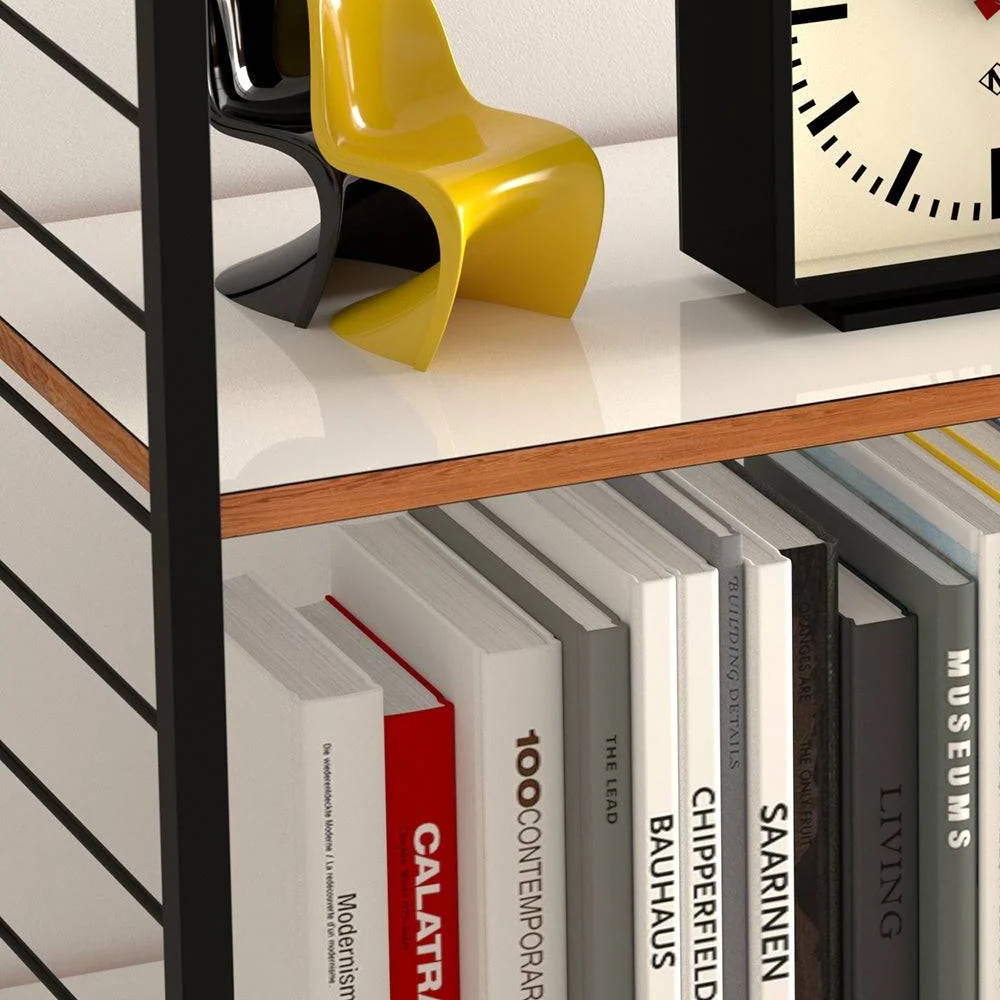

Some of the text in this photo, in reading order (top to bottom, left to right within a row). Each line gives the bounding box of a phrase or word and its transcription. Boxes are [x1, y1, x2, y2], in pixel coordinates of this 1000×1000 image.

[727, 576, 742, 770] BUILDING DETAILS
[947, 649, 972, 849] MUSEUMS
[606, 735, 619, 825] THE LEAD
[799, 810, 814, 848] FRUIT
[800, 740, 814, 765] THE
[413, 822, 442, 1000] CALATR
[650, 814, 676, 970] BAUHAUS
[692, 787, 718, 1000] CHIPPERFIELD
[761, 802, 789, 983] SAARINEN
[880, 784, 903, 940] LIVING
[336, 893, 359, 1000] Modernism
